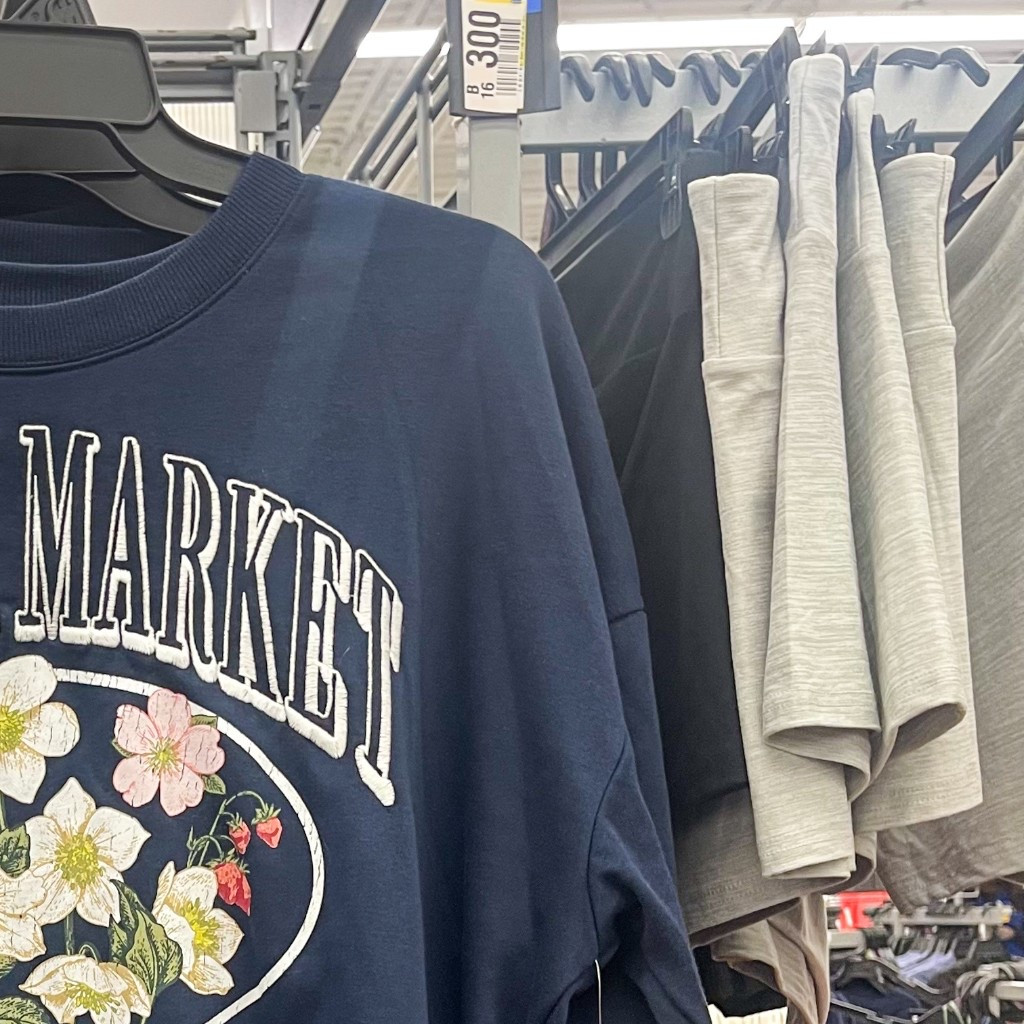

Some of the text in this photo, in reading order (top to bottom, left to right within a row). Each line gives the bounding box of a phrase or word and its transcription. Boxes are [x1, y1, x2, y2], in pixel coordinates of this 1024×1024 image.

[466, 10, 501, 68] 300
[466, 85, 480, 95] B
[481, 82, 495, 99] 16
[13, 424, 404, 807] MARKET
